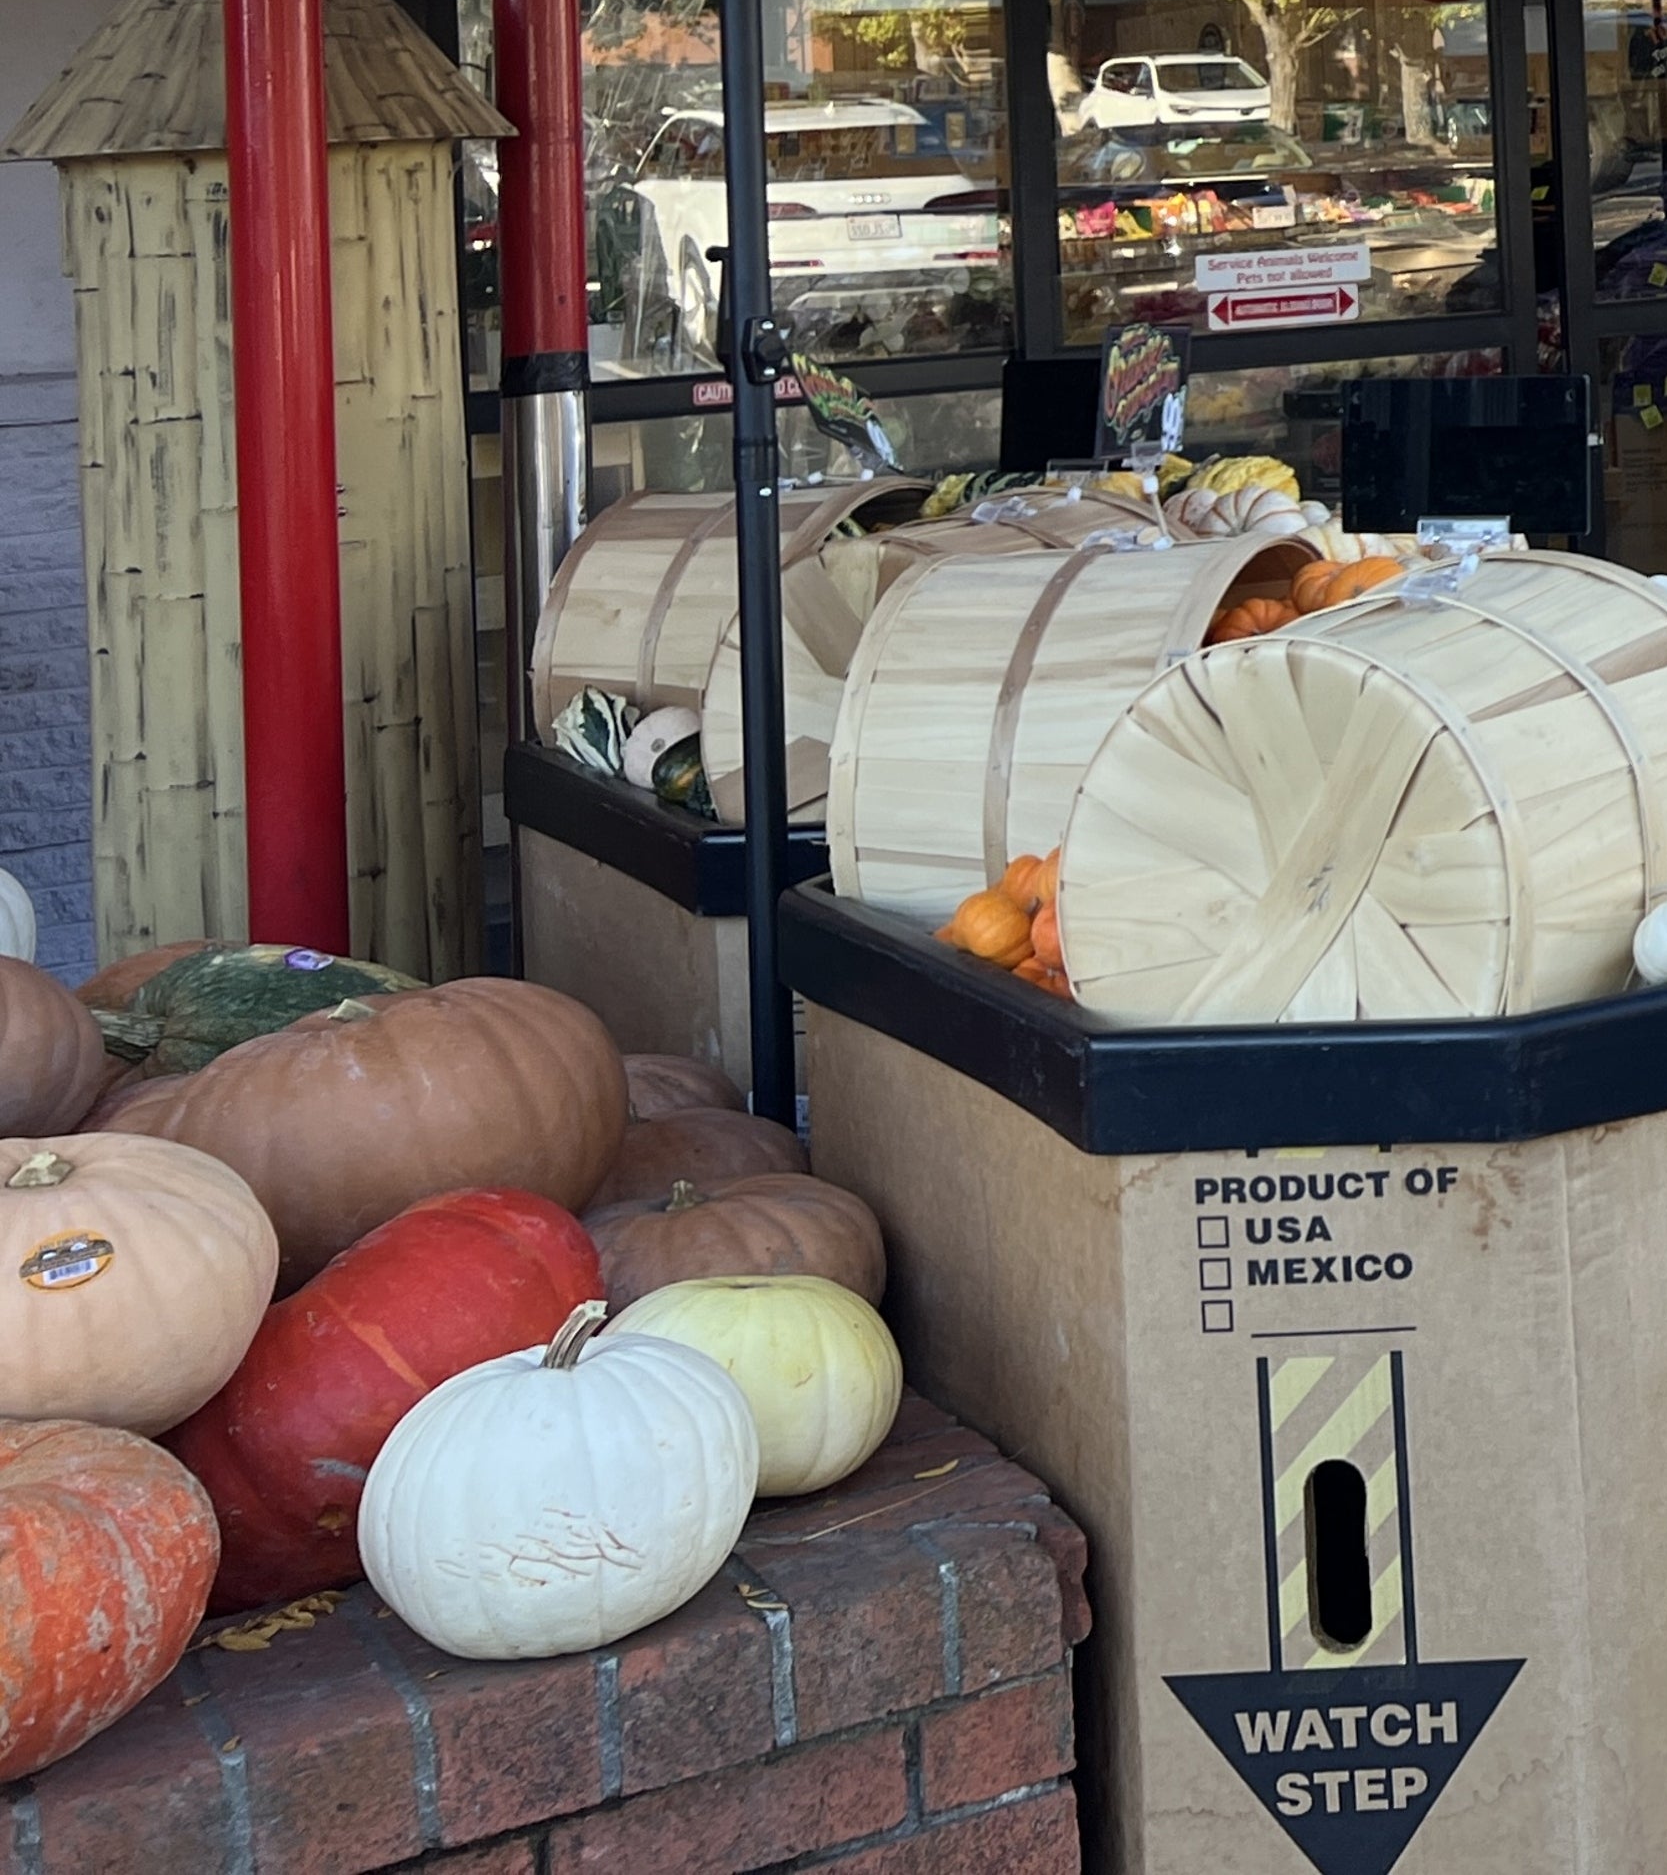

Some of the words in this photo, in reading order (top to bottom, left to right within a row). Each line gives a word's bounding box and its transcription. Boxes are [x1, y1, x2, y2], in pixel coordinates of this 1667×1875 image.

[1207, 258, 1253, 271] Service
[1257, 255, 1304, 268] Animals
[1307, 251, 1359, 264] Welcome
[1236, 272, 1264, 285] Pets
[1267, 270, 1286, 283] not
[1289, 267, 1333, 281] allowed
[1194, 1170, 1391, 1205] PRODUCT
[1404, 1166, 1459, 1196] OF
[1245, 1215, 1333, 1245] USA
[1246, 1252, 1413, 1287] MEXICO
[1234, 1700, 1459, 1755] WATCH
[1275, 1766, 1429, 1817] STEP
